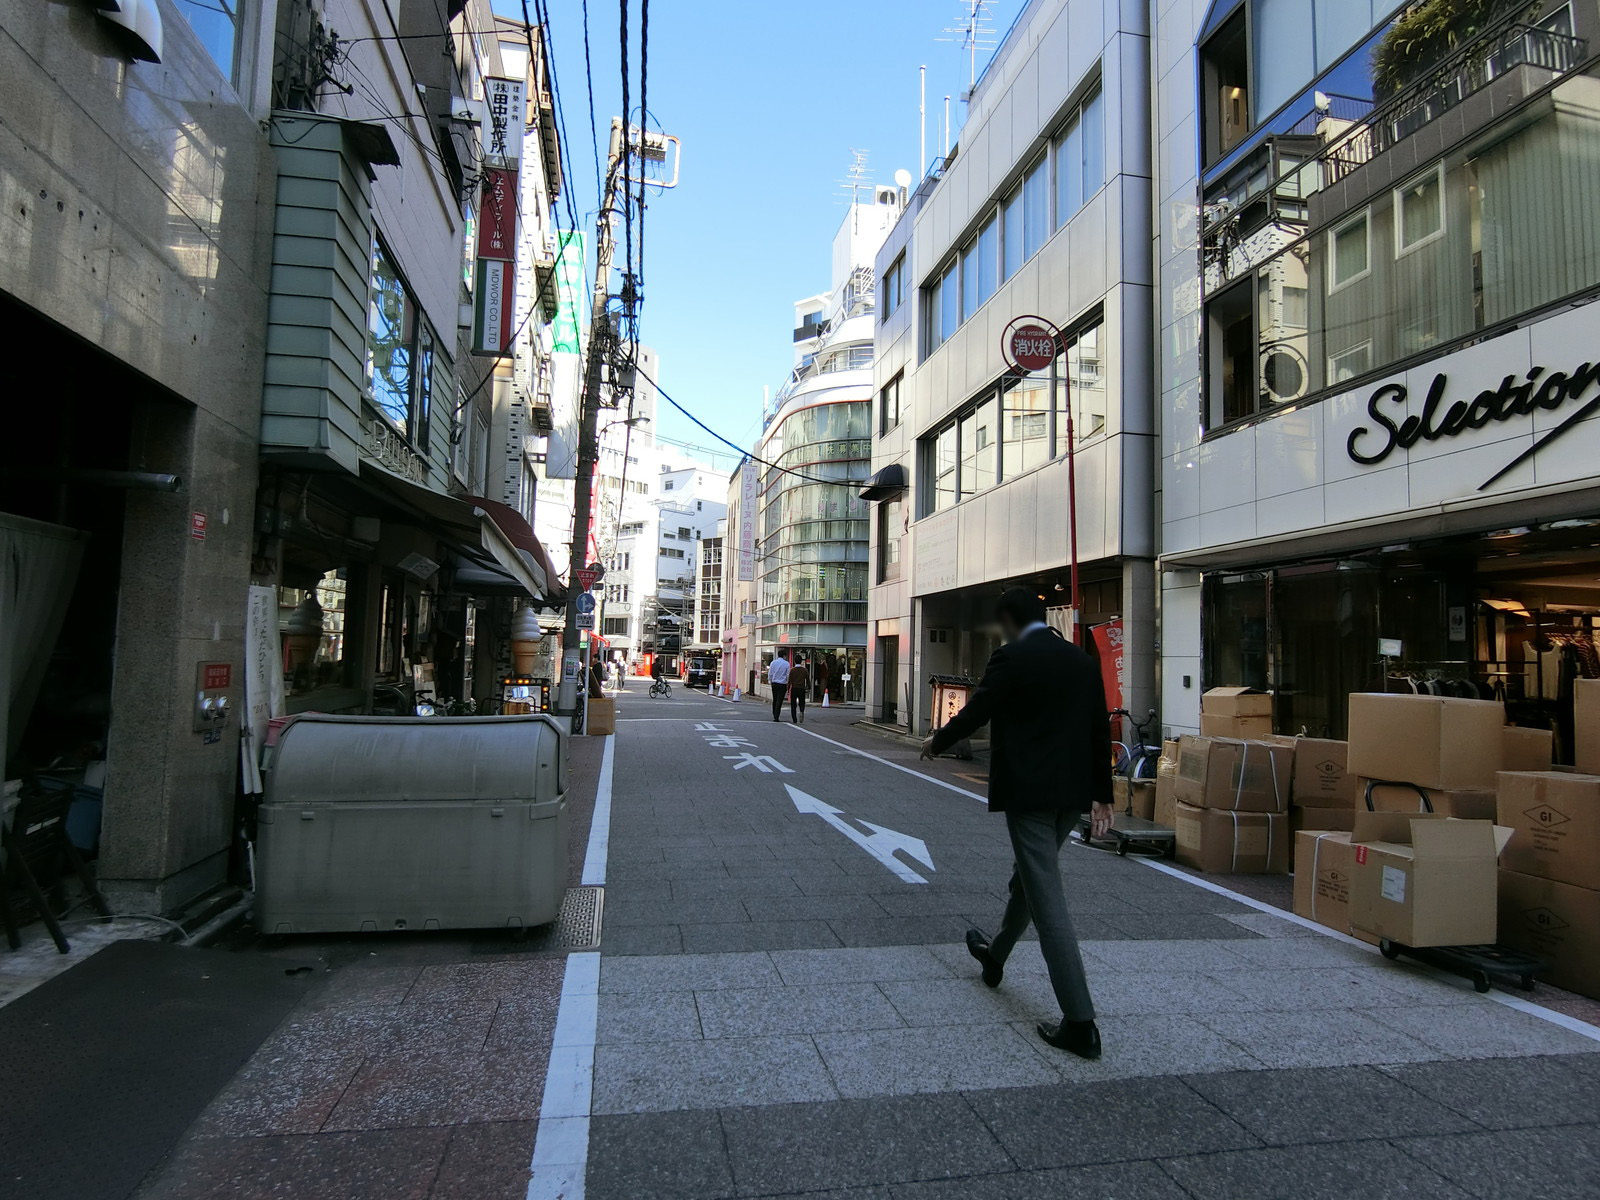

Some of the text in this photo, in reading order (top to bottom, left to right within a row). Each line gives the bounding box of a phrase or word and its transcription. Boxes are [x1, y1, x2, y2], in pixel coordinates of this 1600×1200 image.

[489, 268, 500, 305] MDWOR
[1014, 339, 1052, 357] 消火栓
[744, 474, 753, 519] リラレーヌ
[694, 721, 796, 773] 止まれ
[1540, 811, 1552, 822] GI
[1538, 913, 1550, 925] GI
